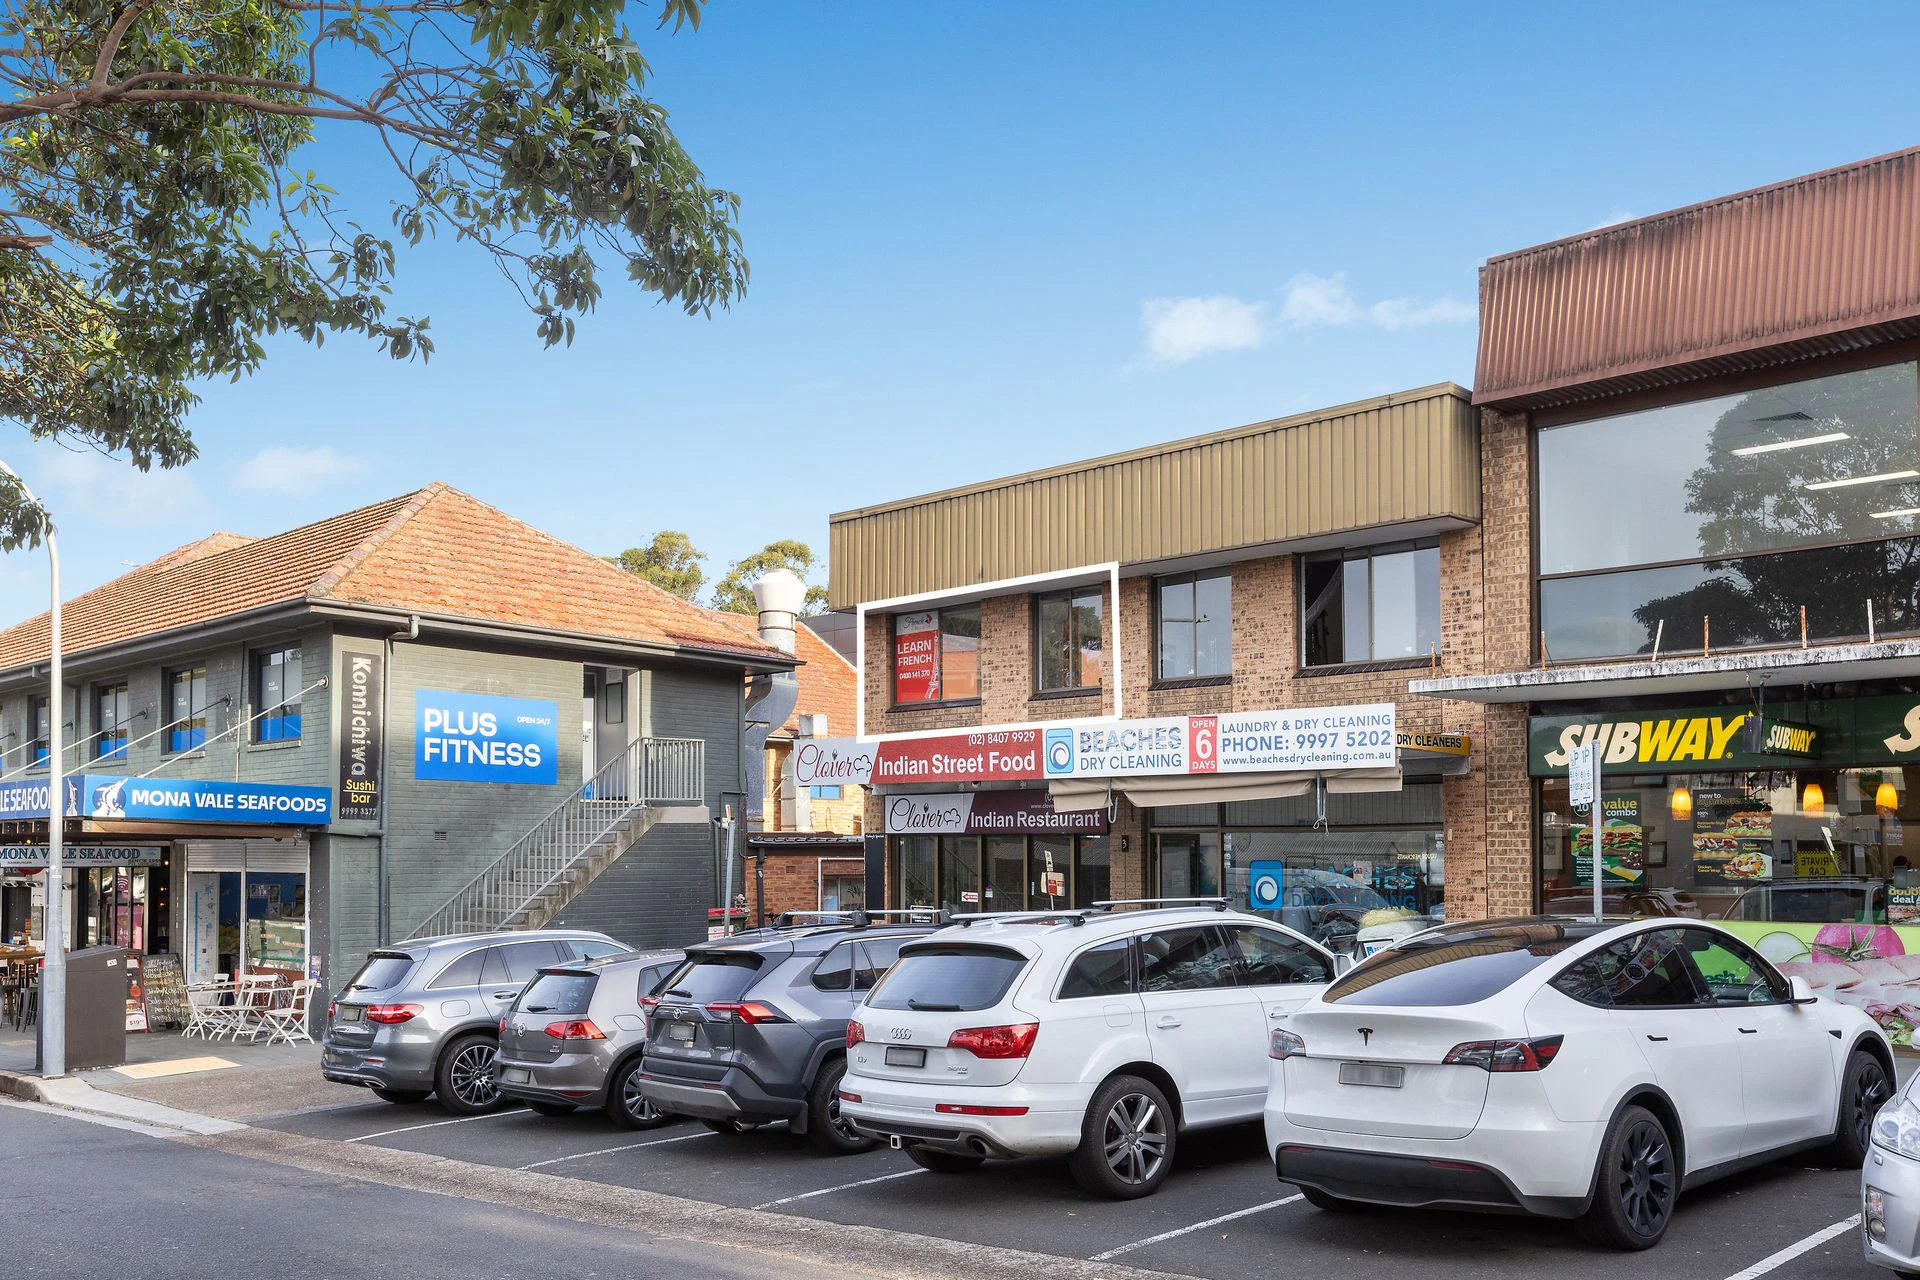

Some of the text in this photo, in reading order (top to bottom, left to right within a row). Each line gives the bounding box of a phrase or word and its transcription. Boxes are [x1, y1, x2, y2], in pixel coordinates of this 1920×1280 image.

[897, 639, 932, 654] LEARN
[898, 653, 932, 667] FRENCH
[351, 657, 371, 776] Konnichiwa
[424, 707, 497, 737] PLUS
[516, 716, 536, 724] OPEN
[1191, 719, 1215, 728] OPEN
[1221, 714, 1391, 734] LAUNDRY & DRY CLEANING
[968, 731, 1036, 746] (02) 8407 9929
[1080, 726, 1182, 753] BEACHES
[1195, 728, 1213, 760] 6
[1221, 730, 1391, 752] PHONE: 9997 5202
[1396, 733, 1462, 748] DRY CLEANERS
[1544, 711, 1754, 768] SUBWAY
[1766, 724, 1817, 752] SUBWAY
[424, 737, 542, 767] FITNESS
[1222, 752, 1391, 765] www.beachesdrycleaning.com.au
[796, 744, 854, 783] Clover
[879, 749, 1036, 776] Indian Street Food
[1080, 753, 1182, 770] DRY CLEANING
[1191, 760, 1216, 770] DAYS
[346, 779, 375, 791] Sushi
[10, 786, 51, 812] SEAFOO
[131, 789, 327, 813] MONA VALE SEAFOODS
[351, 793, 371, 804] bar
[1603, 797, 1638, 810] value
[889, 797, 944, 832] Clover
[971, 810, 1101, 828] Indian Restaurant
[1605, 806, 1637, 817] combo
[0, 847, 141, 860] MONA VLE SEAFOOD
[1892, 895, 1914, 904] deal
